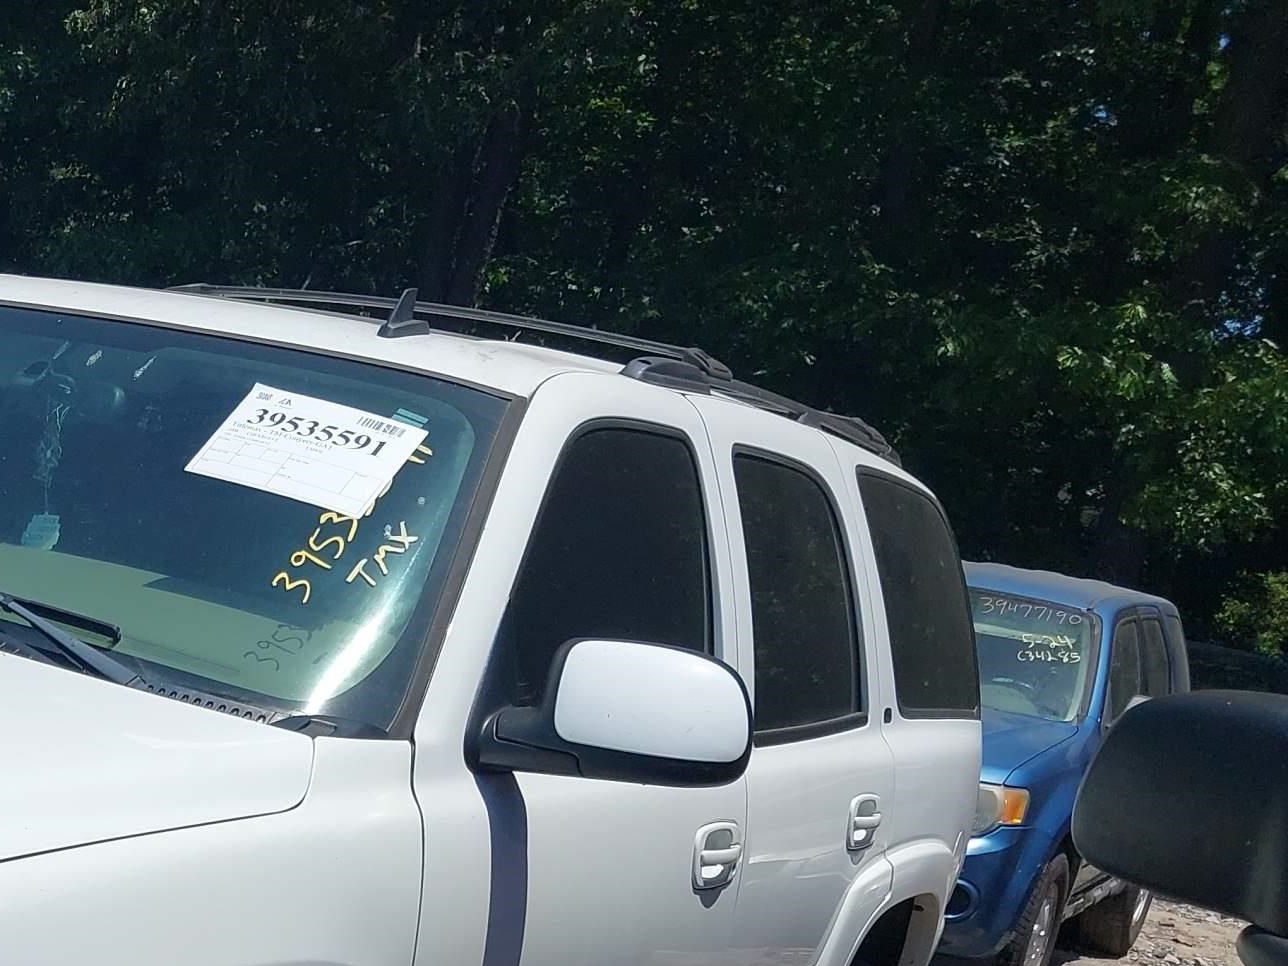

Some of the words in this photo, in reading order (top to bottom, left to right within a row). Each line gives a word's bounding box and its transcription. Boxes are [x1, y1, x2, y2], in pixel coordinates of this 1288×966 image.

[246, 408, 388, 457] 39535591
[980, 597, 1082, 625] 39477190
[1022, 633, 1074, 650] 5-24
